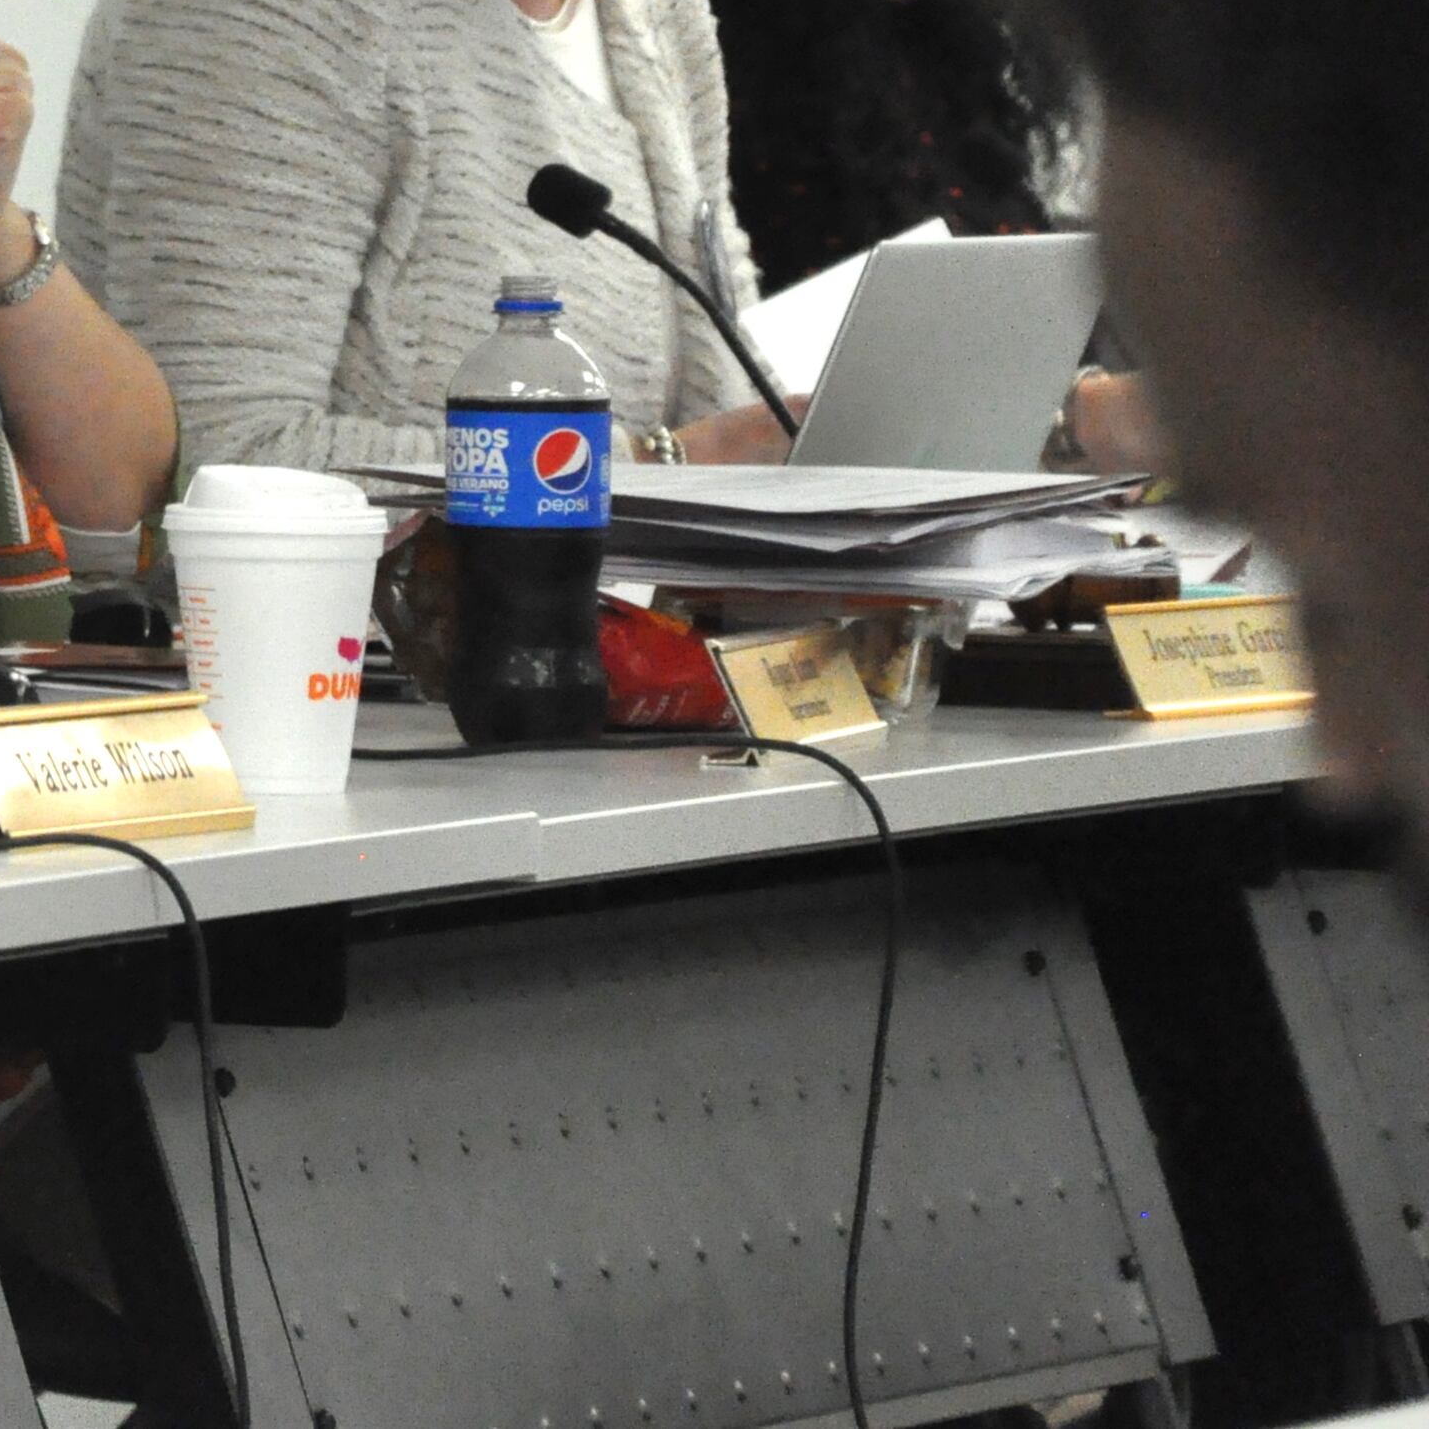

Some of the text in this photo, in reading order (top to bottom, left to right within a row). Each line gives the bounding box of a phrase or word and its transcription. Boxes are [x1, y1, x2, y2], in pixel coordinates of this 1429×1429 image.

[447, 448, 508, 475] OPA
[538, 495, 588, 515] pepsi
[15, 740, 195, 795] Valerie Wilson
